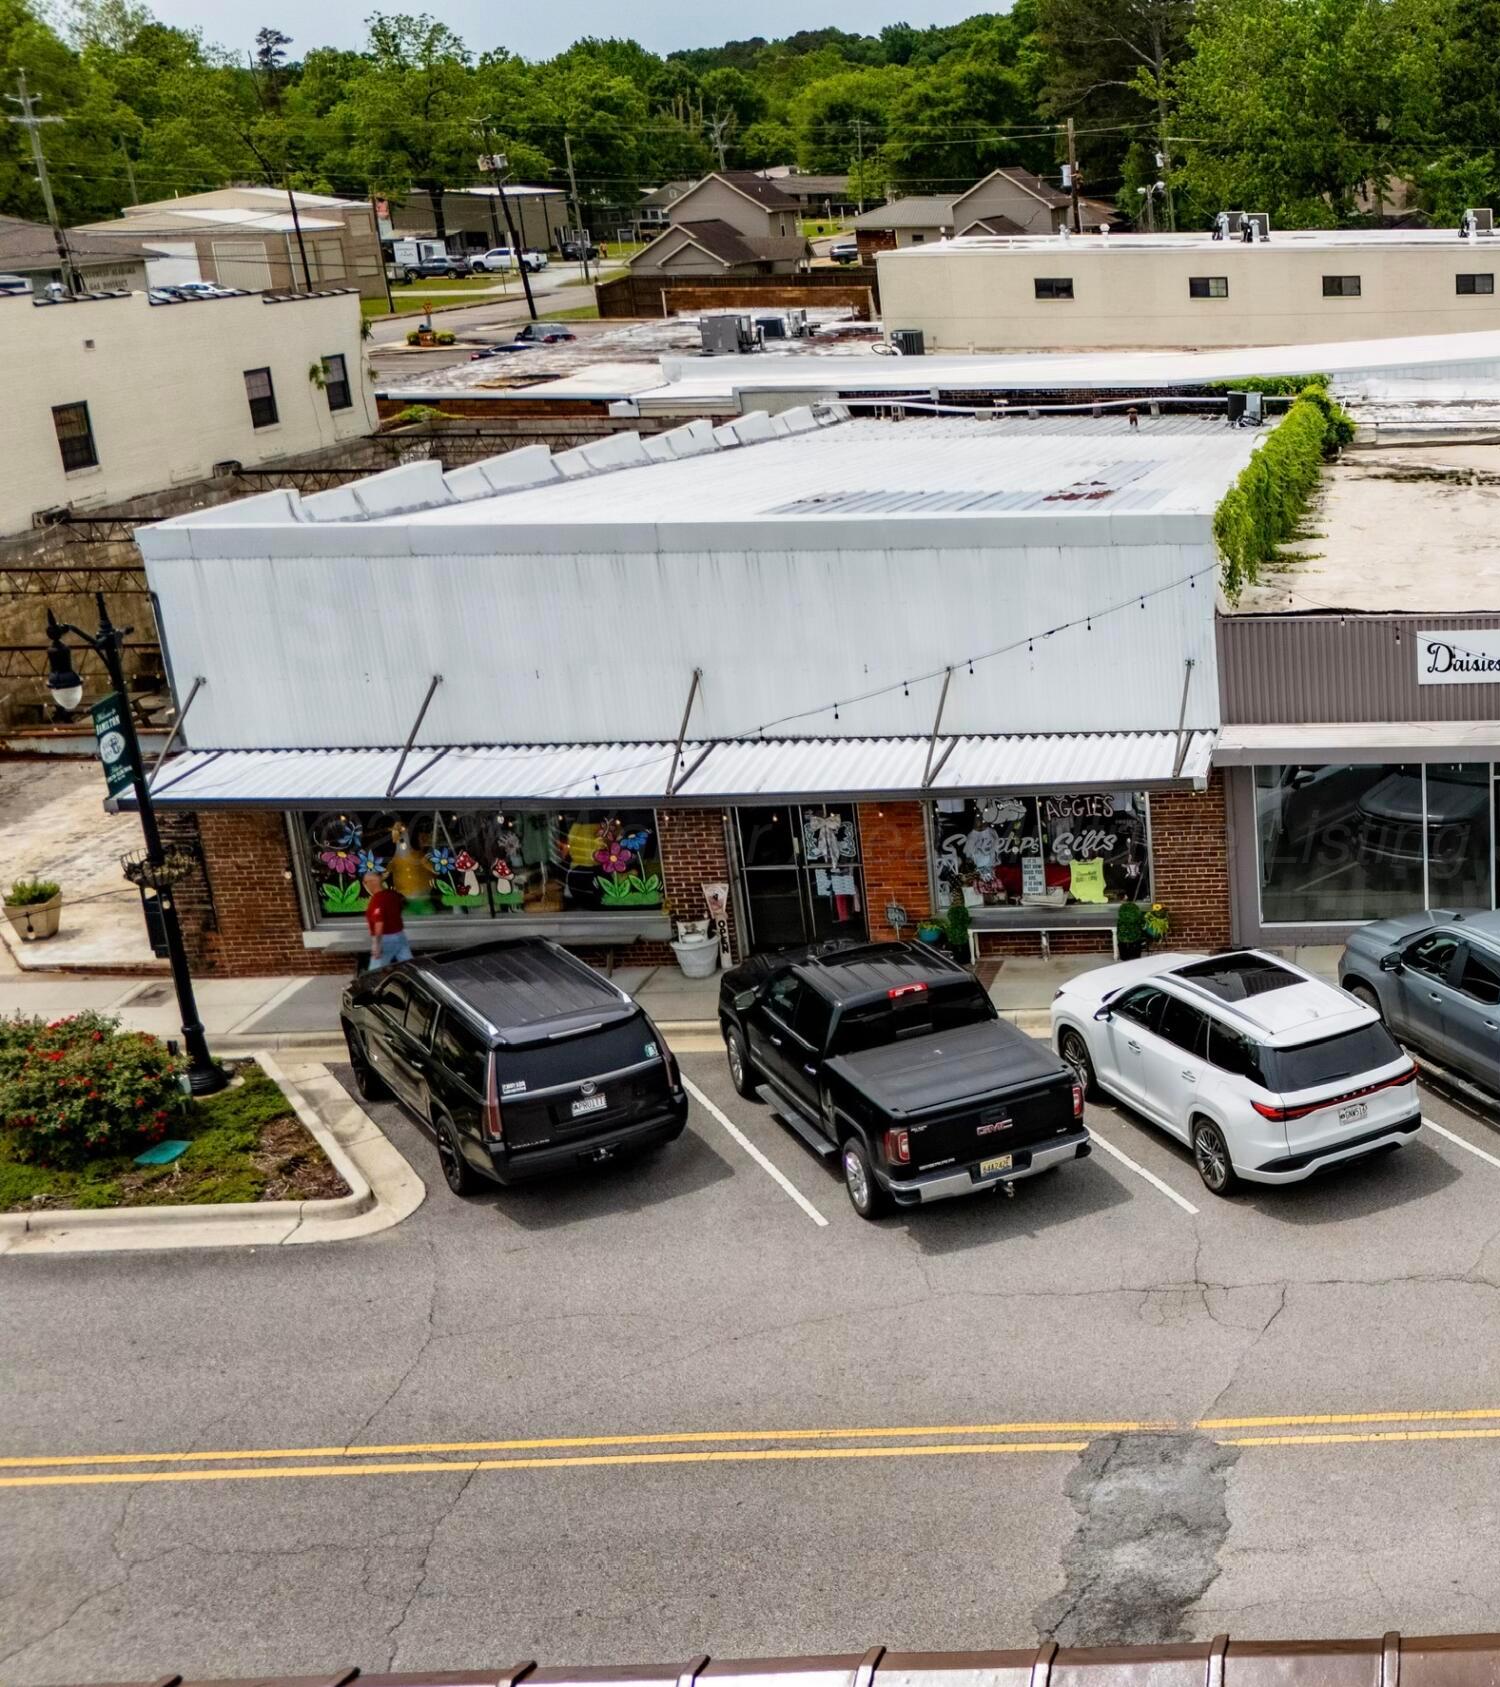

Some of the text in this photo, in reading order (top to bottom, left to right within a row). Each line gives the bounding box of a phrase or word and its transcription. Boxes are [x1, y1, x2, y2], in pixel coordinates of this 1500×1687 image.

[1047, 796, 1114, 820] AGGIES
[1052, 829, 1118, 858] Gifts
[717, 919, 729, 955] OPEN
[976, 1118, 1013, 1136] GMC
